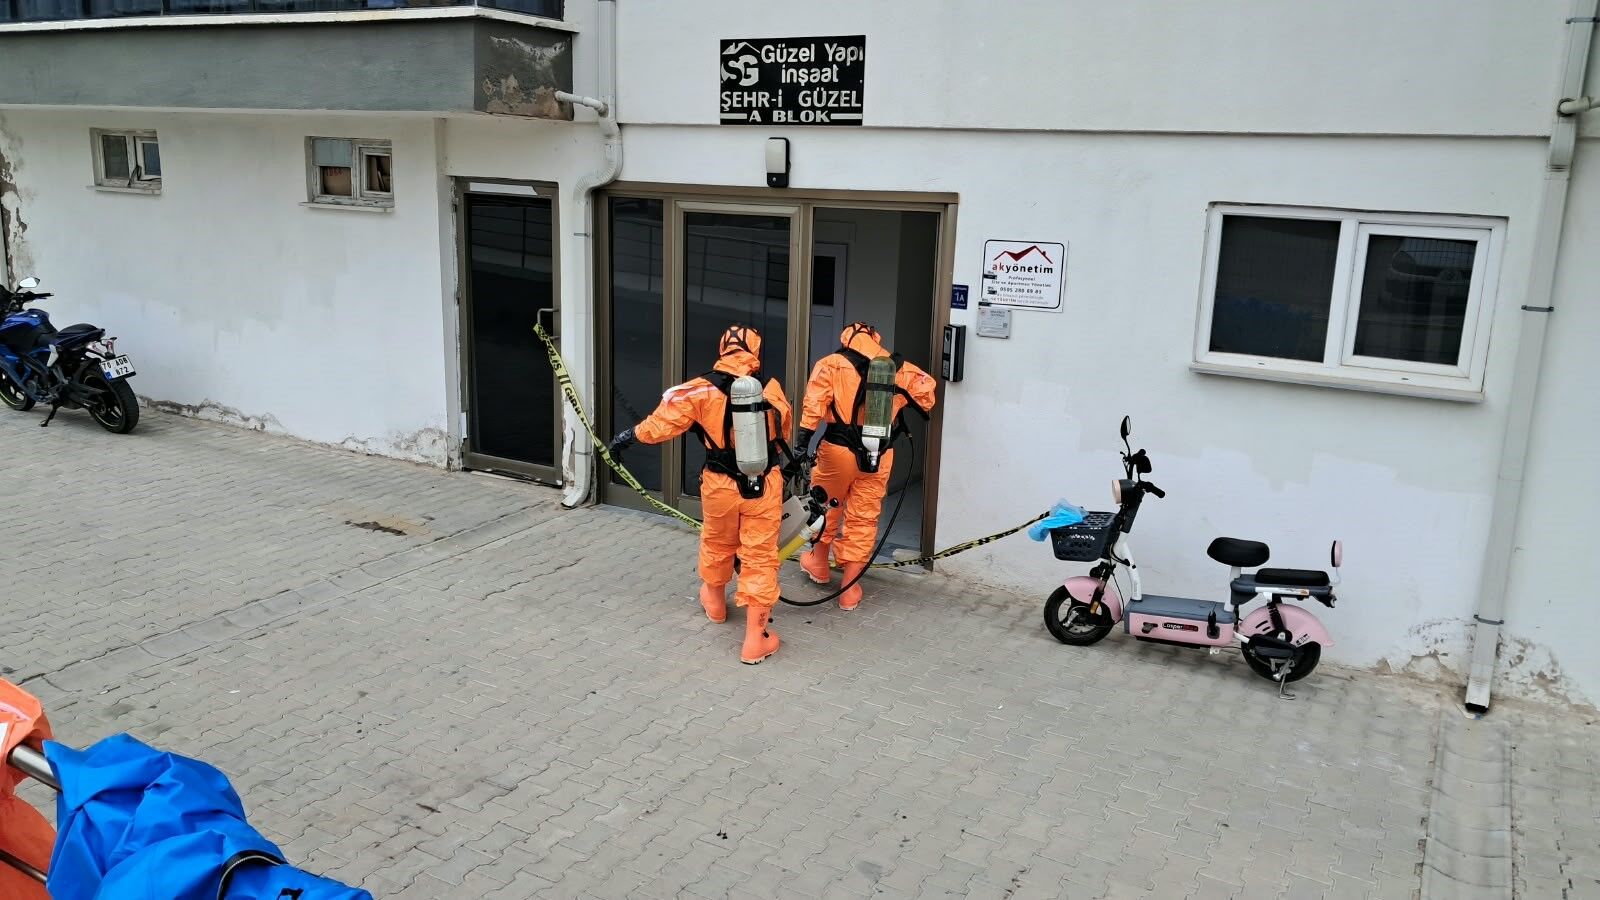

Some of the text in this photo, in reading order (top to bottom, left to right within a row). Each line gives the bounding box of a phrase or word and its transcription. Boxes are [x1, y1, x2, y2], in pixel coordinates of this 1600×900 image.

[761, 43, 864, 66] Güzel Yapı
[798, 87, 862, 108] GÜZEL
[749, 110, 831, 123] A BLOK
[992, 262, 1053, 274] akyönetim
